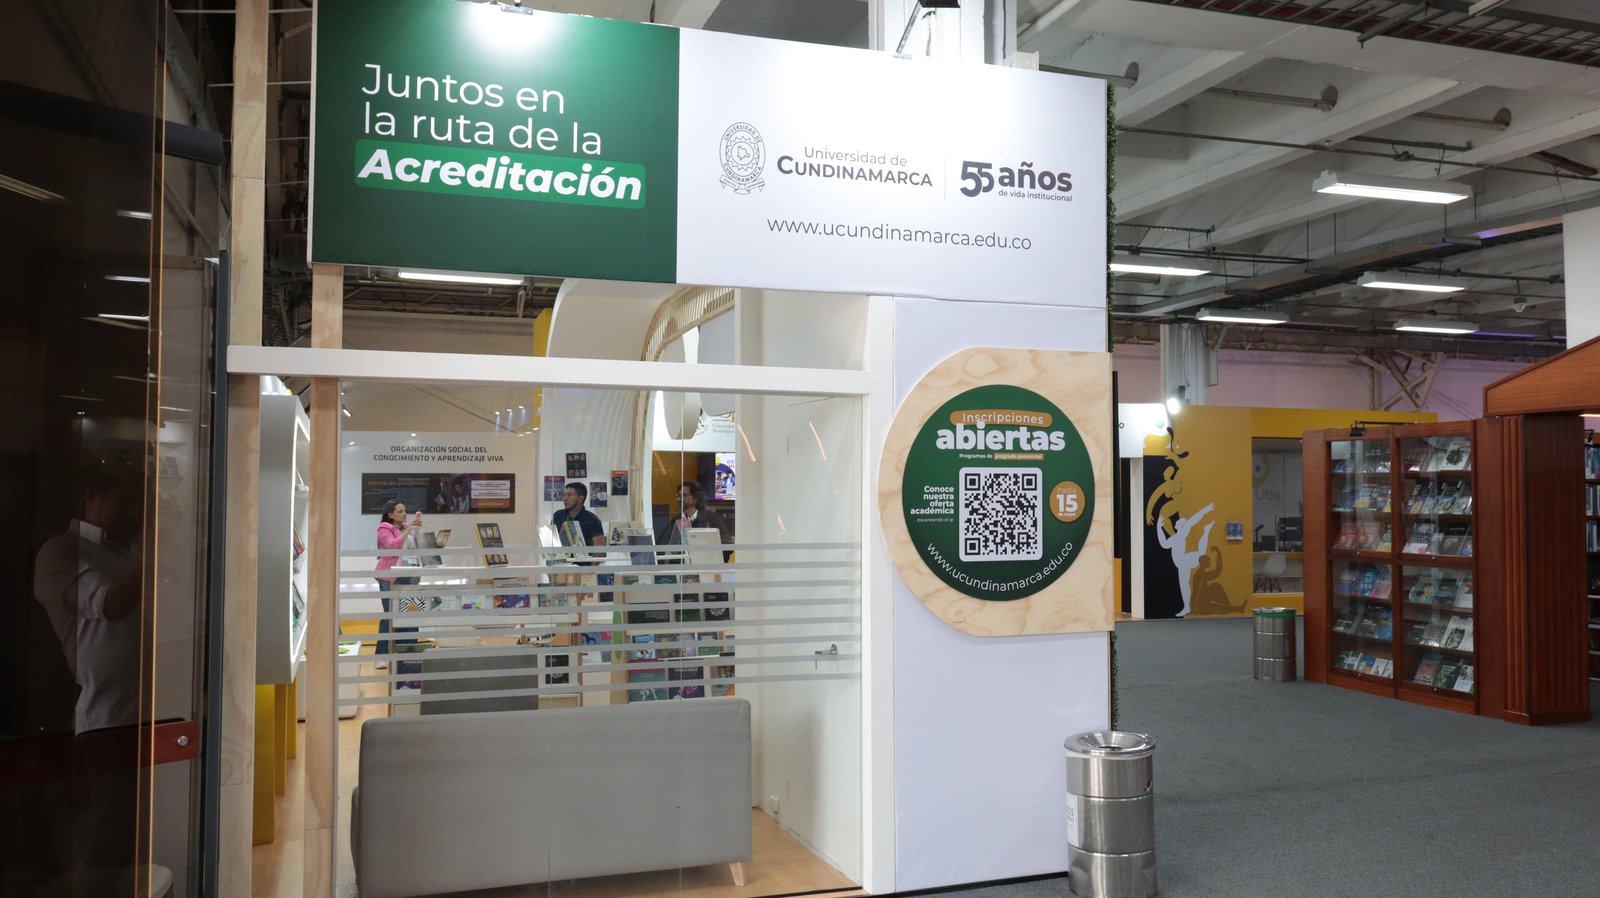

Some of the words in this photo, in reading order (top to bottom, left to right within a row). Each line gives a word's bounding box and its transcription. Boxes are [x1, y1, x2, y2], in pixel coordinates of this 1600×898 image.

[361, 63, 505, 109] Juntos
[516, 85, 565, 114] en
[363, 101, 396, 136] la
[412, 114, 495, 145] ruta
[508, 117, 559, 151] de
[572, 121, 602, 155] la
[804, 146, 886, 165] Universidad
[890, 155, 907, 167] de
[357, 148, 643, 201] Acreditación
[723, 162, 762, 183] CUNDINAMARCA
[777, 155, 933, 187] CUNDINAMARCA
[960, 160, 995, 198] 55
[998, 161, 1073, 192] años
[998, 189, 1008, 197] de
[1009, 190, 1026, 198] vida
[1027, 191, 1073, 202] institucional
[766, 218, 1032, 251] www.ucundinamarca.edu.co
[962, 413, 1044, 425] Inscripciones
[936, 421, 1066, 451] abiertas
[373, 454, 430, 462] CONOCIMIENTO
[431, 454, 436, 462] Y
[437, 455, 486, 463] APRENDIZAJE
[390, 445, 447, 453] ORGANIZACIÓN
[923, 485, 954, 493] Conoce
[910, 507, 954, 515] académica
[1056, 494, 1078, 513] 15
[927, 542, 1073, 592] www.ucundinamarca.edu.co
